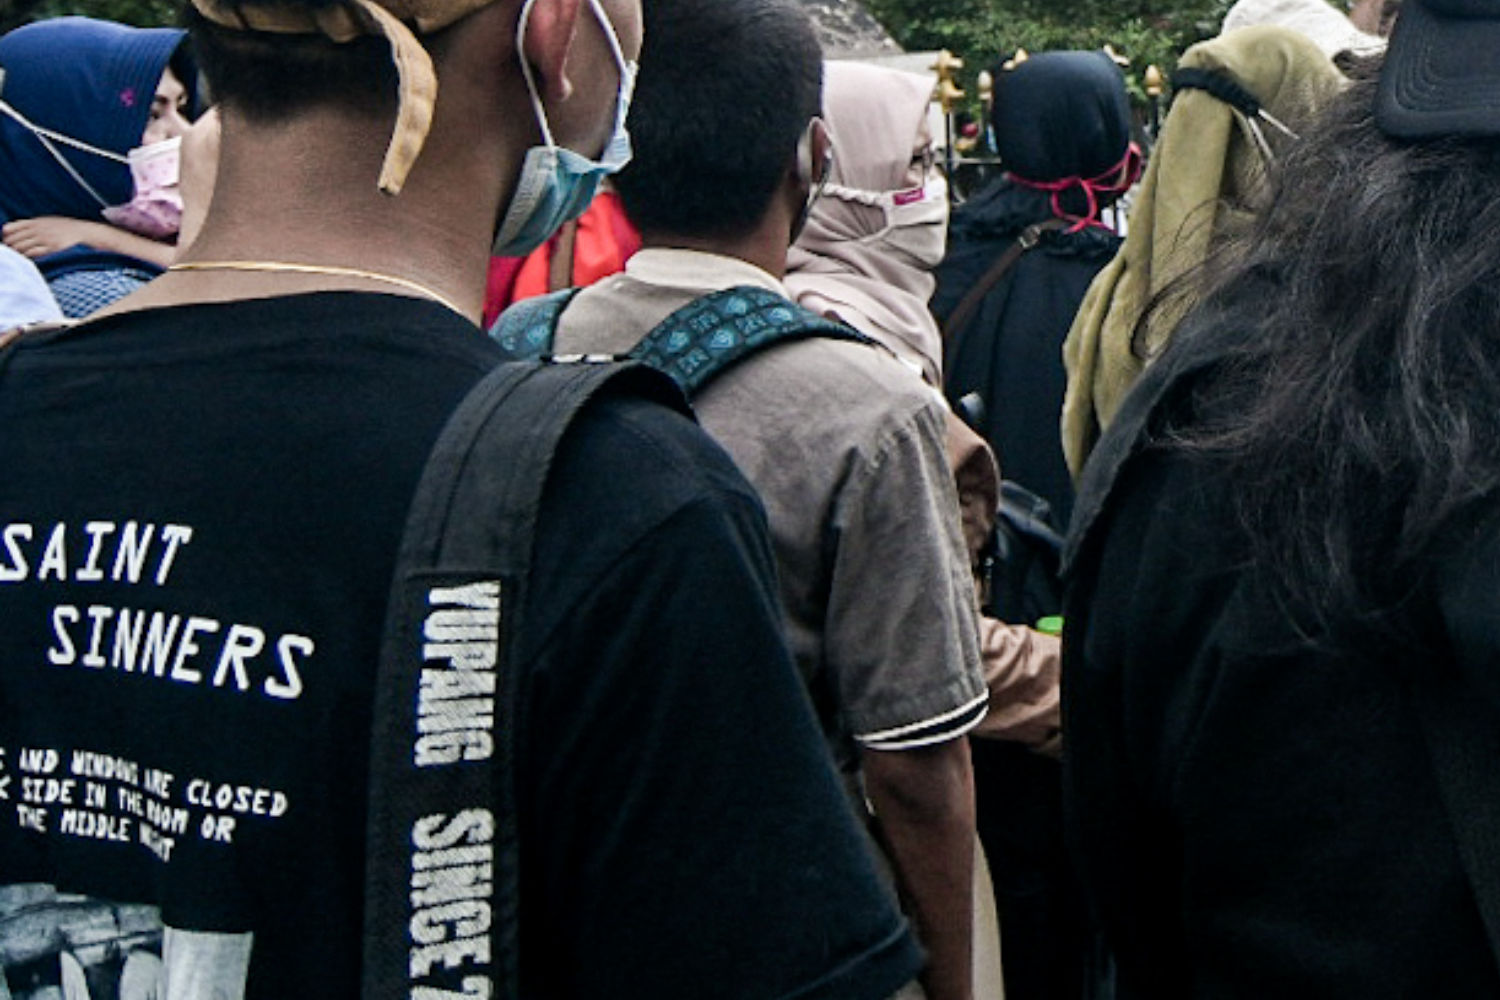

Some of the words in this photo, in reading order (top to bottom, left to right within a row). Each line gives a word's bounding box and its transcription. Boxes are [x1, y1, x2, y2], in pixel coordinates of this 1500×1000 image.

[0, 520, 193, 585] SAINT
[48, 604, 315, 699] SINNERS
[414, 580, 500, 767] YUPANG
[19, 747, 59, 774] AND
[186, 778, 289, 817] CLOSED
[22, 775, 77, 804] SIDE
[85, 781, 107, 808] IN
[118, 787, 144, 817] THE
[200, 813, 236, 843] OR
[16, 802, 48, 833] THE
[60, 808, 131, 842] MIDDLE
[409, 807, 495, 979] SINCE
